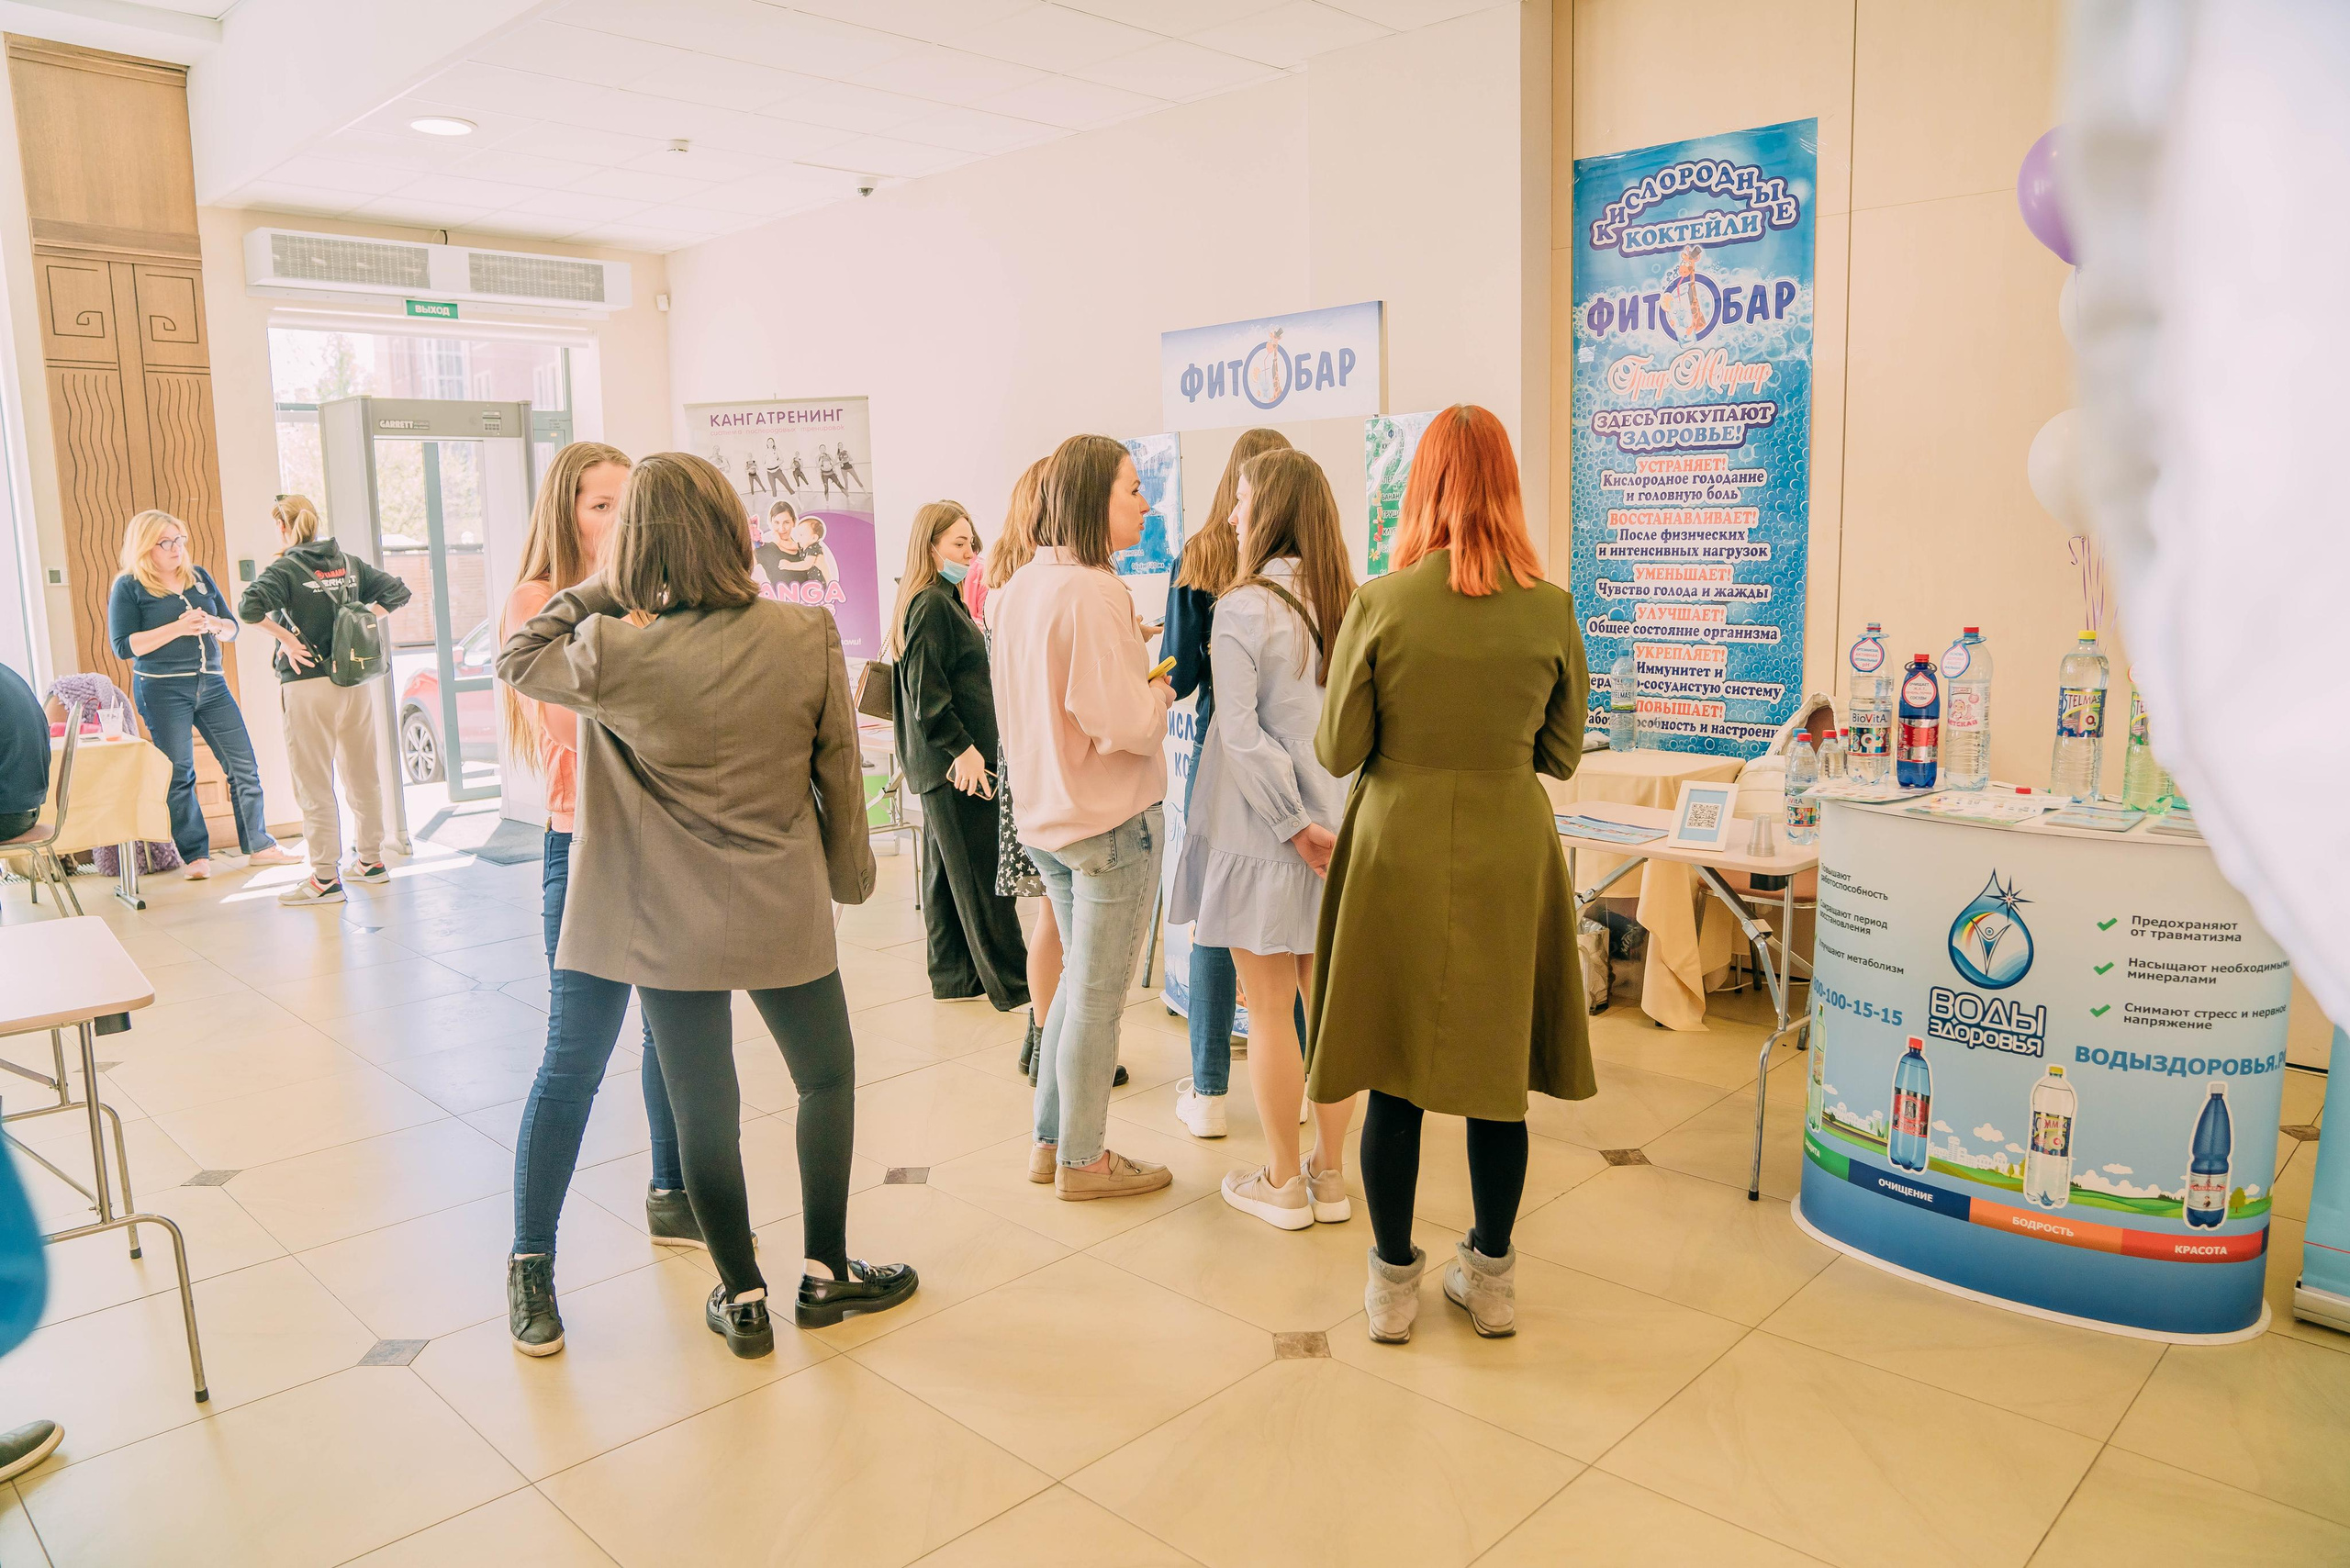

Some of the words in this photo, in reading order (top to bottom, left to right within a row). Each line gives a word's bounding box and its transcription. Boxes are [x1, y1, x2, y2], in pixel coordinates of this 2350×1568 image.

[1595, 163, 1794, 242] КИСЛОРОДНЫЕ
[1625, 215, 1759, 250] КОКТЕЙЛИ
[415, 304, 450, 317] ВЫХОД
[1587, 273, 1796, 342] ФИТОБАР
[1180, 341, 1356, 410] ФИТОБАР
[1609, 353, 1670, 401] Граф
[1671, 347, 1773, 397] Жираф
[379, 420, 414, 429] GARRETT
[710, 408, 844, 428] КАНГАТРЕНИНГ
[1596, 413, 1653, 431] ЗДЕСЬ
[1660, 406, 1772, 426] ПОКУПАЮТ
[1622, 425, 1742, 447] ЗДОРОВЬЕ!
[1637, 457, 1727, 475] УСТРАНЯЕТ!
[1603, 474, 1689, 488] Кислородное
[1692, 472, 1764, 487] голодание
[1626, 491, 1634, 502] и
[1637, 488, 1703, 505] головную
[1707, 485, 1739, 500] боль
[1609, 510, 1758, 526] ВОССТАНАВЛИВАЕТ!
[1619, 528, 1657, 541] После
[1661, 527, 1746, 543] физических
[1598, 546, 1607, 556] и
[1609, 546, 1699, 557] интенсивных
[1702, 546, 1768, 560] нагрузок
[1635, 566, 1732, 582] УМЕНЬШАЕТ!
[758, 580, 846, 604] ANGA
[1598, 582, 1651, 599] Чувство
[1653, 585, 1698, 598] голода
[1701, 587, 1710, 598] и
[1713, 587, 1769, 599] жажды
[1637, 606, 1725, 622] УЛУЧШАЕТ!
[1589, 617, 1630, 636] Общее
[1633, 624, 1699, 638] состояние
[1703, 628, 1778, 641] организма
[1636, 645, 1726, 663] УКРЕПЛЯЕТ!
[1637, 661, 1711, 679] Иммунитет
[1714, 667, 1723, 678] и
[1724, 684, 1783, 700] систему
[1635, 700, 1724, 719] ПОВЫШАЕТ!
[1699, 723, 1708, 733] и
[1853, 913, 1888, 930] период
[2132, 915, 2238, 931] Предохраняют
[2131, 928, 2145, 937] от
[2151, 930, 2242, 943] травматизма
[1847, 952, 1905, 975] метаболизм
[2128, 957, 2207, 975] Насыщают
[2127, 970, 2217, 985] минералами
[1929, 986, 2047, 1038] ВОДЫ
[2124, 1002, 2190, 1018] Снимают
[2194, 1009, 2237, 1020] стресс
[2241, 1010, 2248, 1018] и
[2252, 1003, 2287, 1019] нервное
[2123, 1014, 2212, 1030] напряжение
[1878, 1178, 1933, 1203] ОЧИЩЕНИЕ
[2011, 1215, 2075, 1238] БОДРОСТЬ
[2174, 1244, 2228, 1256] КРАСОТА
